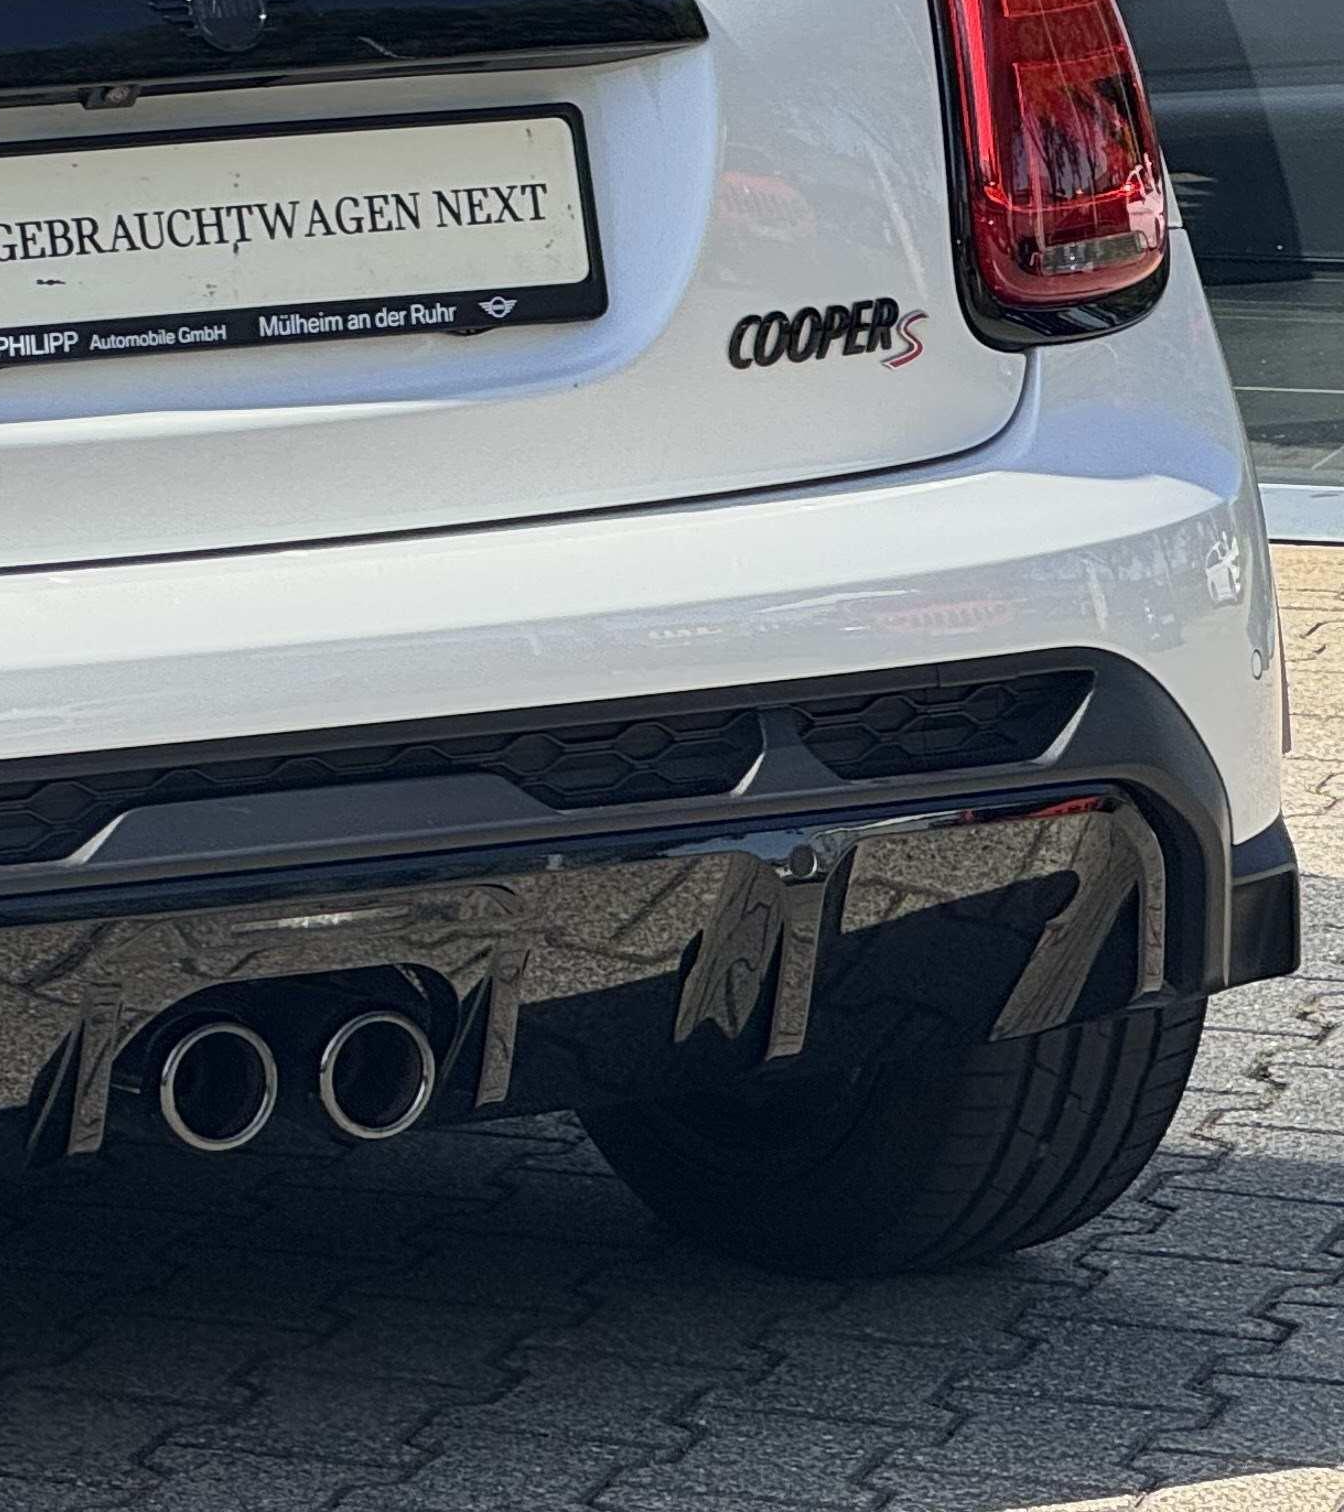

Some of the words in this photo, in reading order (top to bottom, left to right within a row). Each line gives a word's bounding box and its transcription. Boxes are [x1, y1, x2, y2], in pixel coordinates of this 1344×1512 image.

[432, 183, 548, 228] NEXT
[89, 329, 175, 351] Automobile
[178, 324, 227, 345] GmbH
[259, 311, 343, 337] Mülheim
[347, 313, 376, 331] an
[378, 306, 409, 328] der
[412, 303, 457, 326] Ruhr
